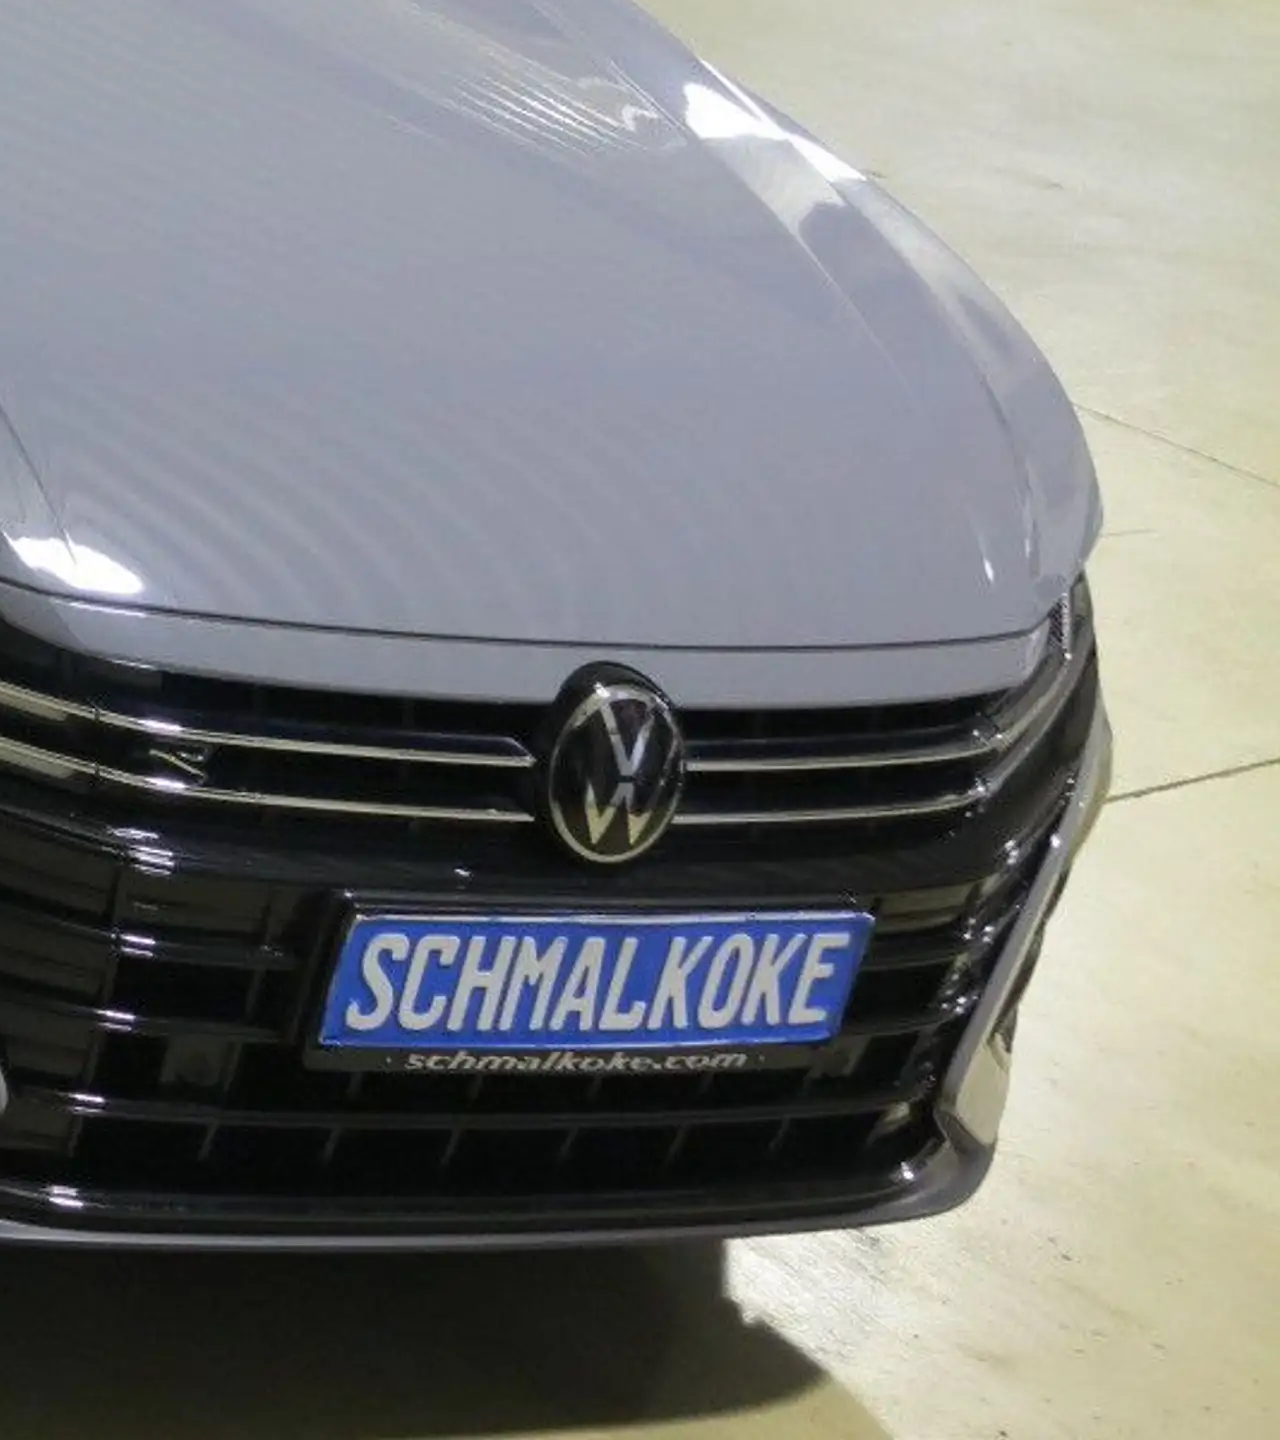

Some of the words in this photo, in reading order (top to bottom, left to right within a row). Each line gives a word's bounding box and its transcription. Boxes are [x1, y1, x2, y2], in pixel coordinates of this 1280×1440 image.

[558, 690, 678, 856] VW
[346, 932, 850, 1030] SCHMALKOKE
[404, 1050, 747, 1071] schmalkoke.com
